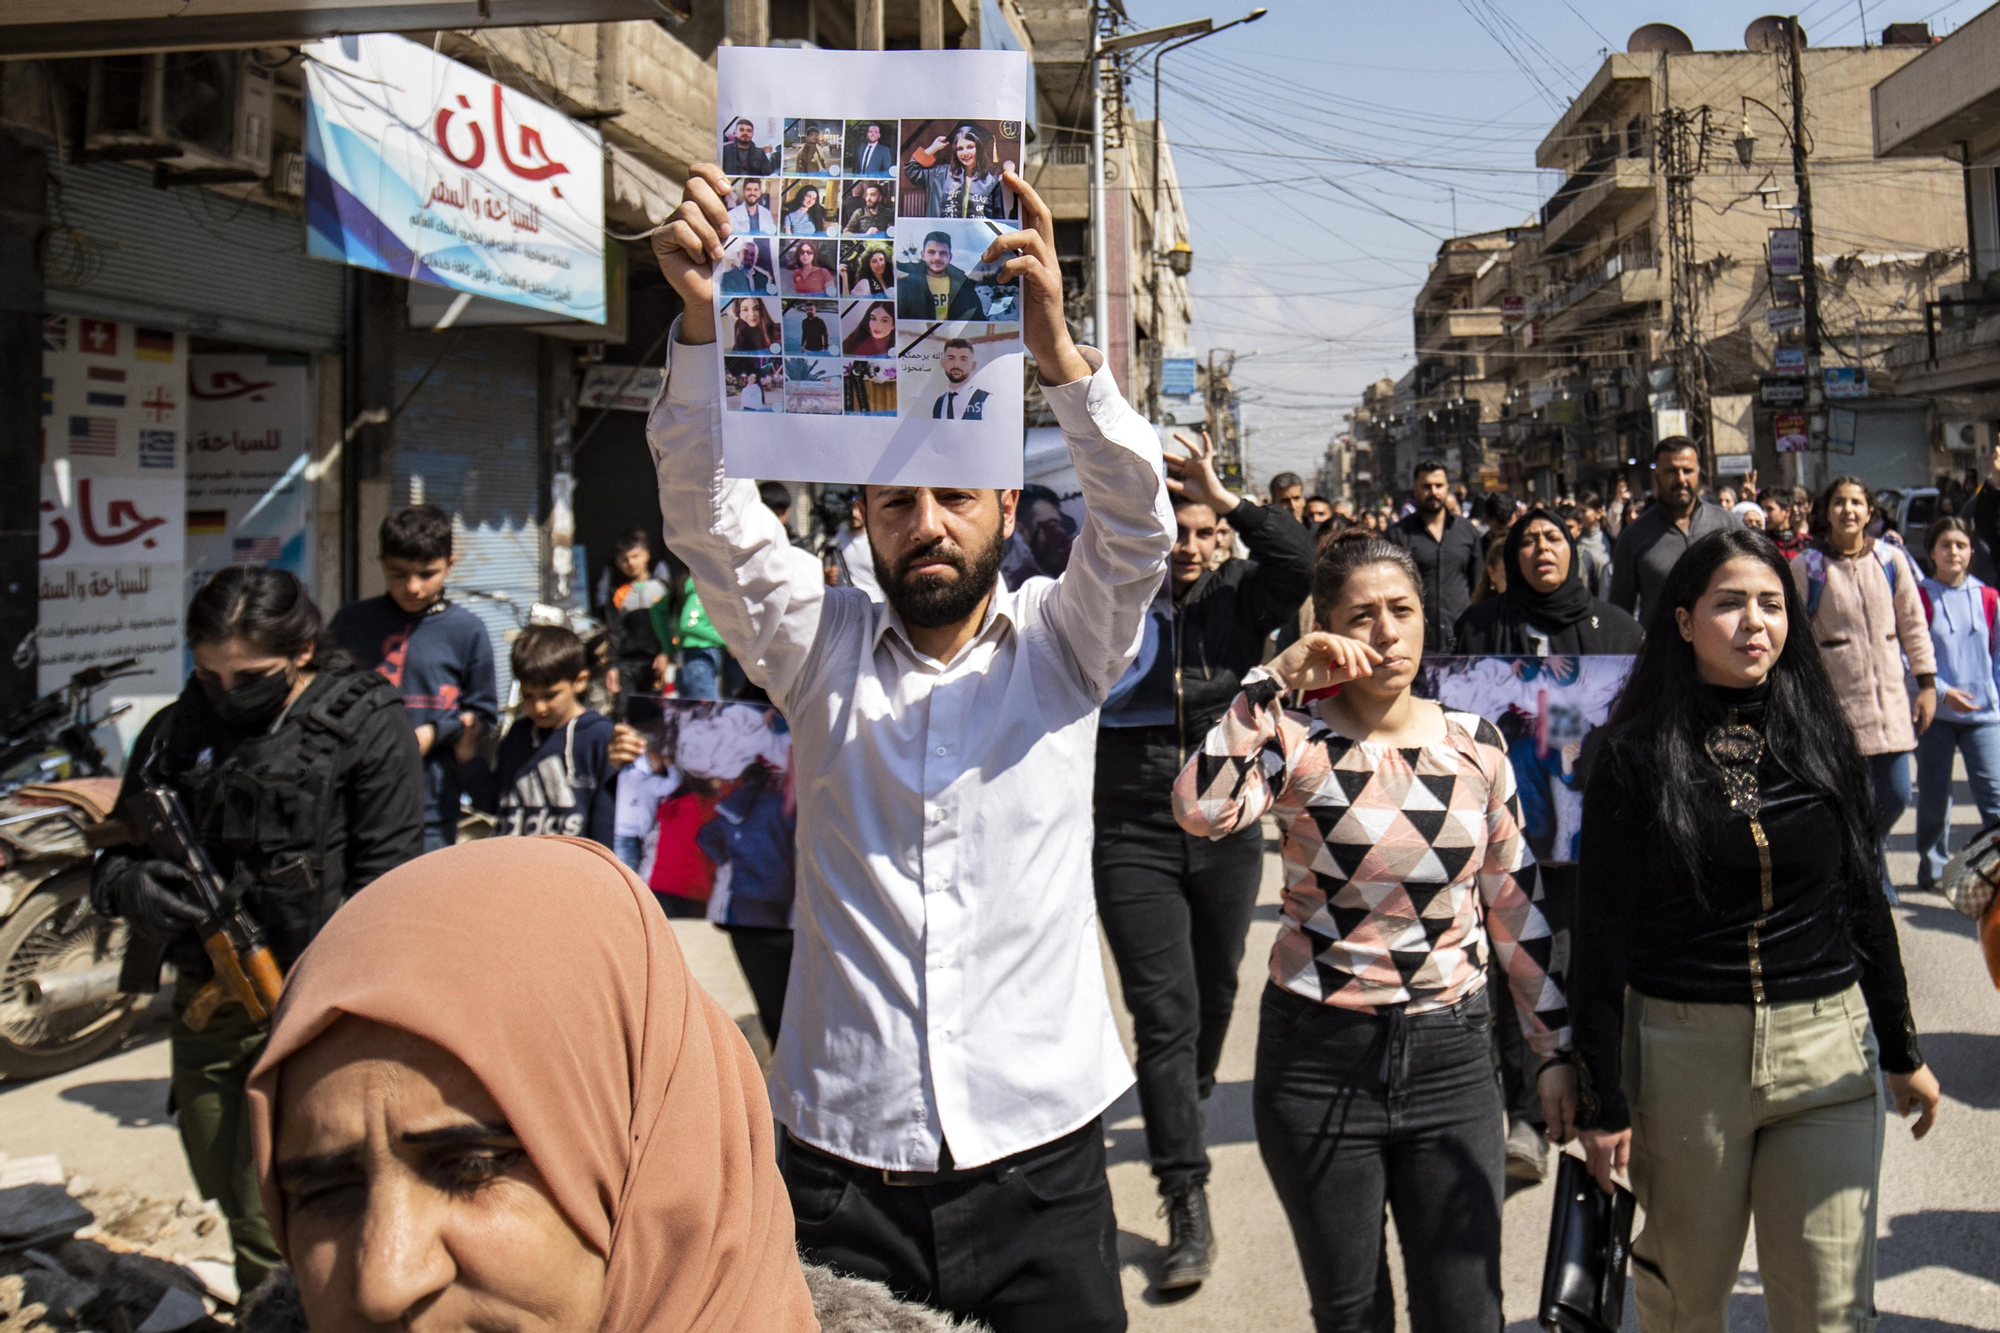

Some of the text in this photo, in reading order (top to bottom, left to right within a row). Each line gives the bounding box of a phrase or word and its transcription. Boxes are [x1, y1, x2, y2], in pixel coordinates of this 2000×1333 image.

[434, 83, 571, 198] جان
[420, 174, 541, 234] للسياحة والسفر
[39, 567, 150, 602] للسياحة والسف
